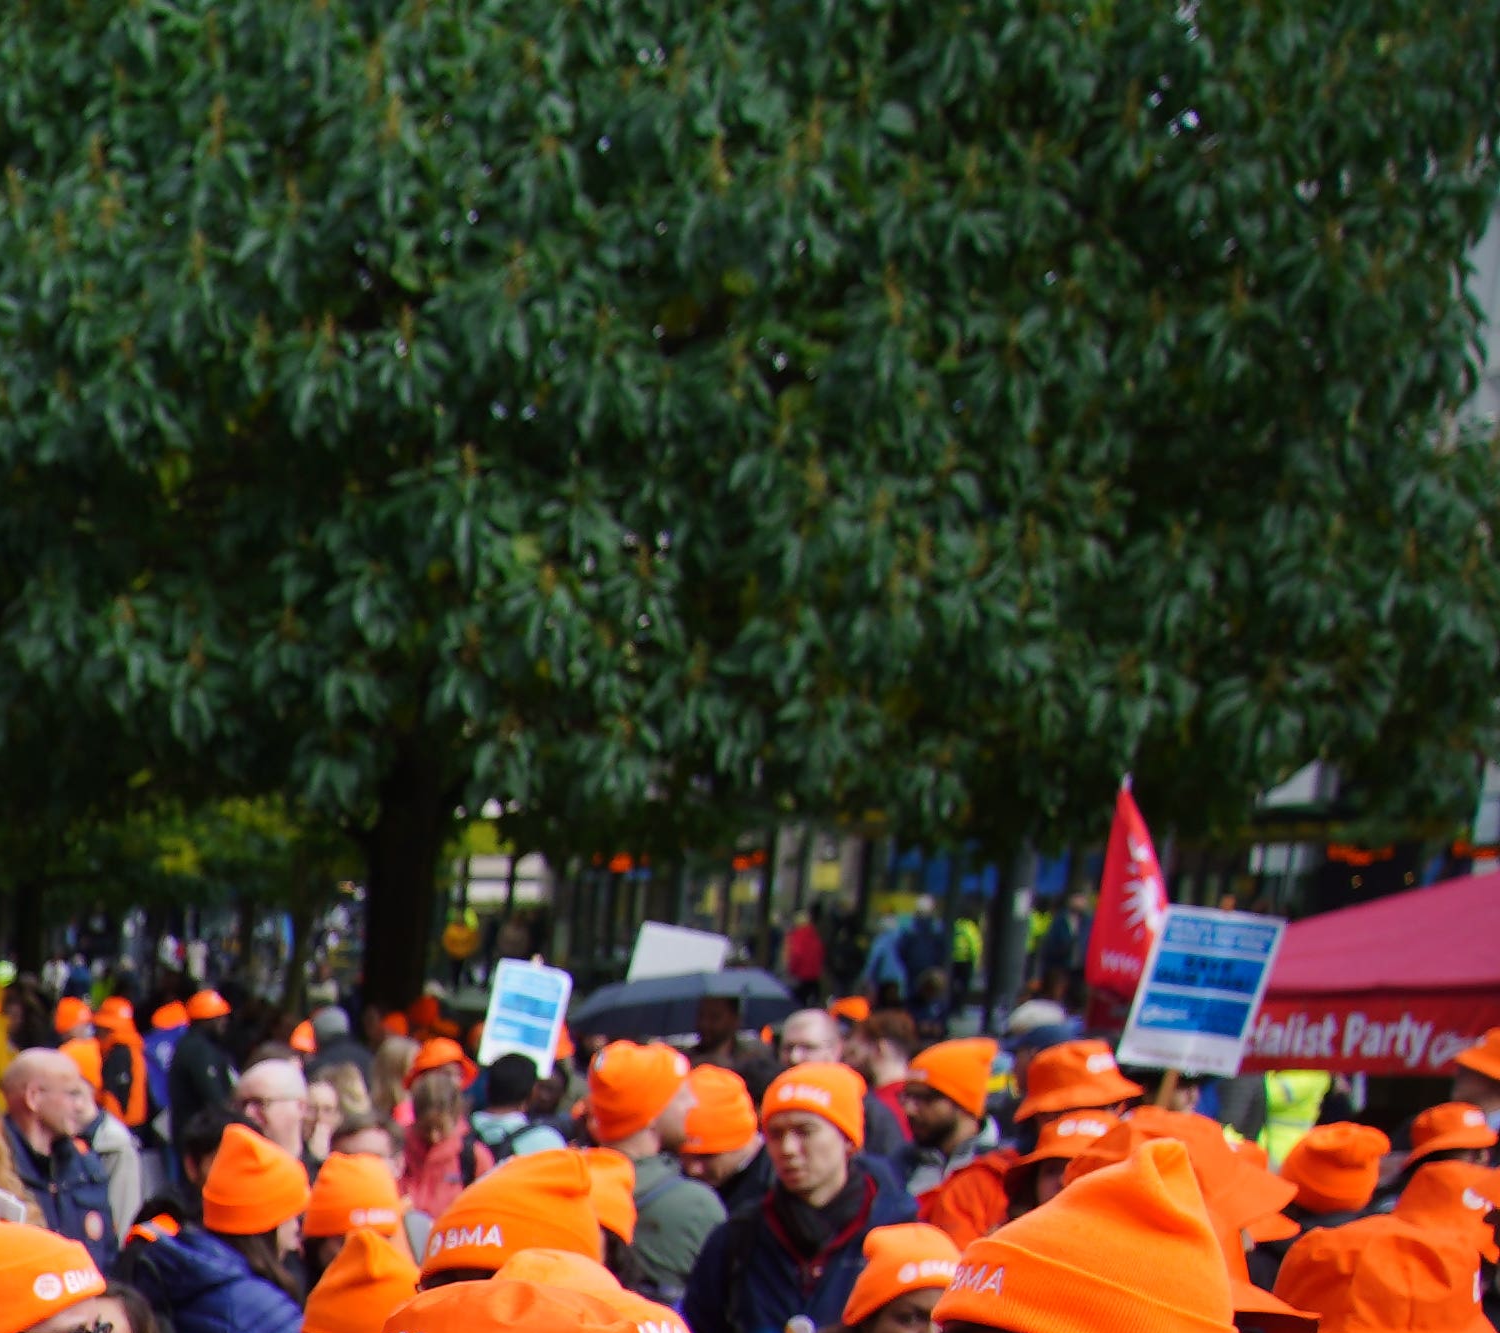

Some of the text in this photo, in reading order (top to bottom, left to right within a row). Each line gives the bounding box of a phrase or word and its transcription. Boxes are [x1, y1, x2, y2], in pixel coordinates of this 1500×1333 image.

[1342, 1010, 1434, 1068] Party
[444, 1224, 504, 1251] BMA
[950, 1263, 1004, 1297] BMA
